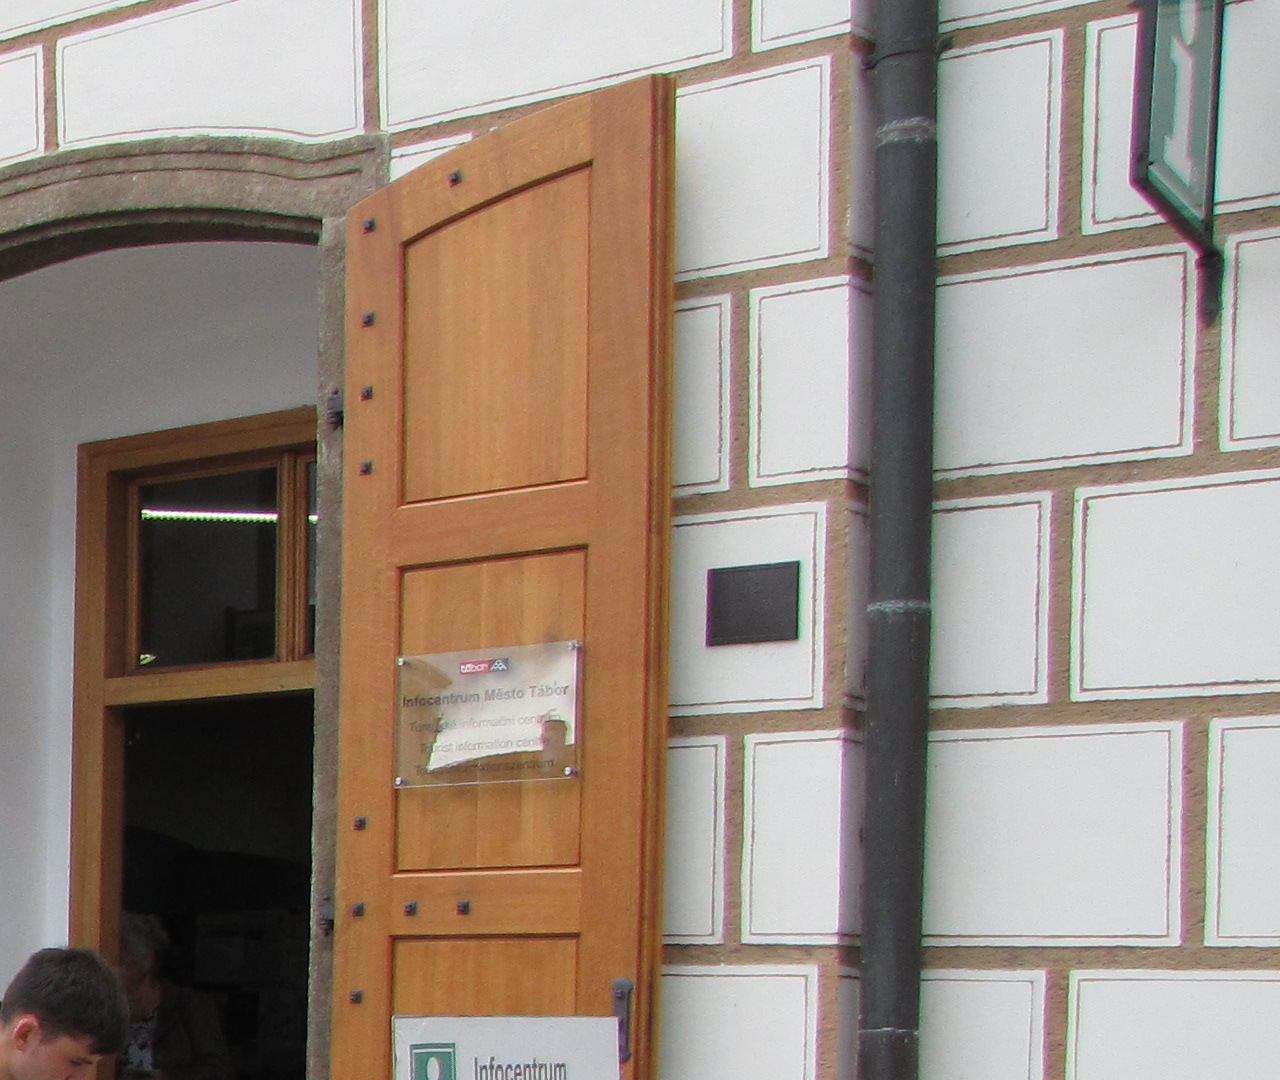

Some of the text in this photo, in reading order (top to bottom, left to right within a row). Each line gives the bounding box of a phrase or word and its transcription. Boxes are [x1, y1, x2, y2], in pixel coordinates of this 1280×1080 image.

[402, 681, 570, 708] Infocentrum Město Tábor
